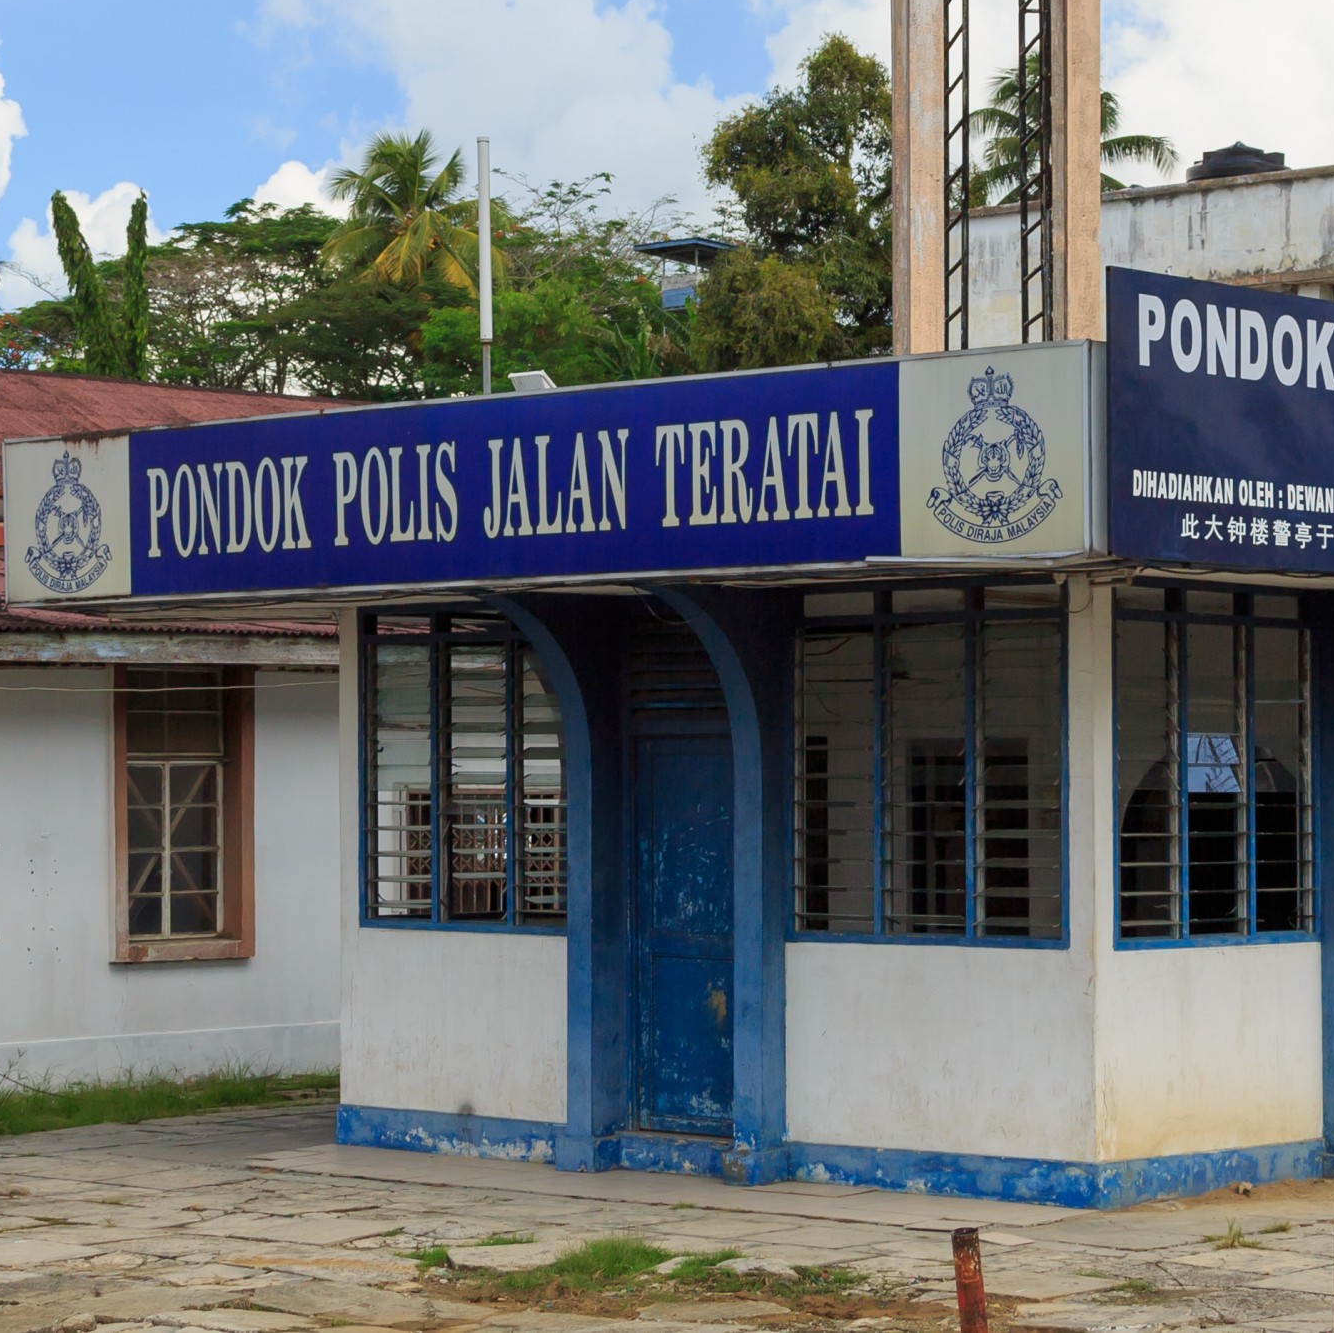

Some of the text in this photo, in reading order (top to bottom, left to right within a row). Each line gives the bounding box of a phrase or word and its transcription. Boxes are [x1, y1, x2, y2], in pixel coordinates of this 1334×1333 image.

[146, 409, 874, 558] PONDOK POLIS JALAN TERATAI
[1132, 469, 1234, 505] DIHADIAHKAN
[1238, 479, 1274, 508] OLEH
[1287, 484, 1334, 514] DEWAN
[937, 501, 1053, 541] POLIS DIRAJA MALAYSIA
[31, 562, 106, 591] POLIS DIRAJA MALAYSIA
